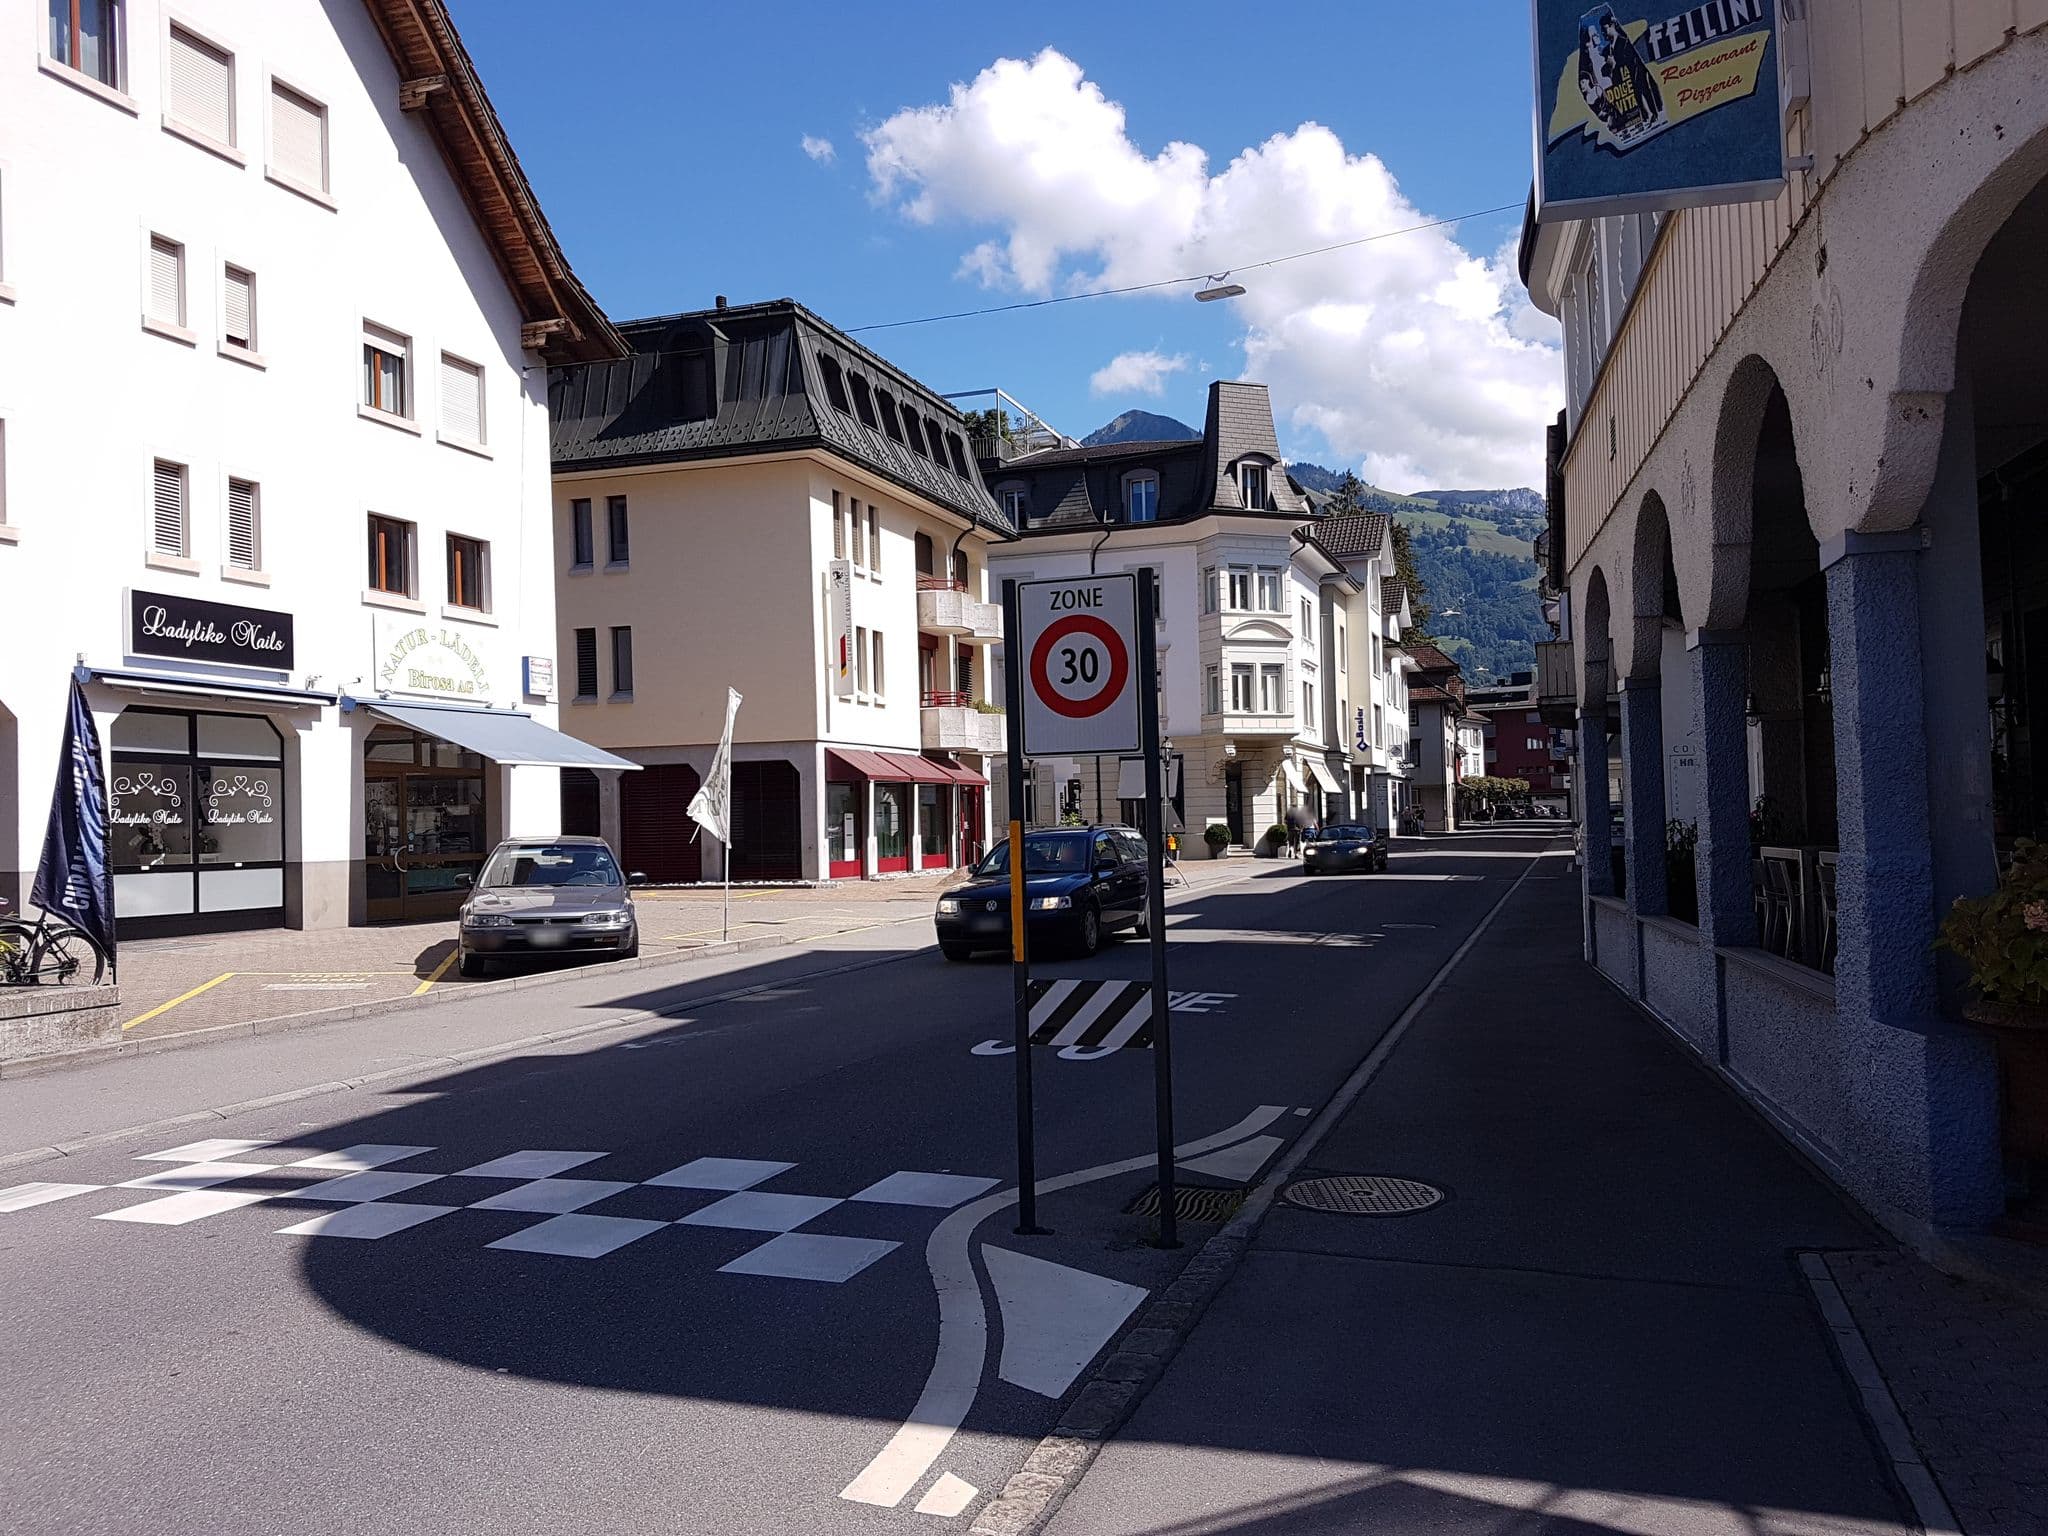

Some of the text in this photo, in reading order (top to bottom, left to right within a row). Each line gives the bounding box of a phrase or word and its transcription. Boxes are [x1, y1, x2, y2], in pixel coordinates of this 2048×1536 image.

[1620, 65, 1631, 80] LA
[1660, 39, 1758, 84] Restaurant
[1606, 80, 1634, 103] DOLCE
[1677, 74, 1744, 107] Pizzeria
[1615, 94, 1638, 115] VITA
[1050, 588, 1103, 610] ZONE
[142, 605, 285, 651] Ladylike Nails
[381, 628, 428, 684] NATUR
[1060, 647, 1099, 684] 30
[408, 668, 474, 693] Birosa AG
[1354, 706, 1364, 738] Basler
[110, 809, 183, 827] Ladylike Nails
[208, 809, 273, 826] Ladylike Nails
